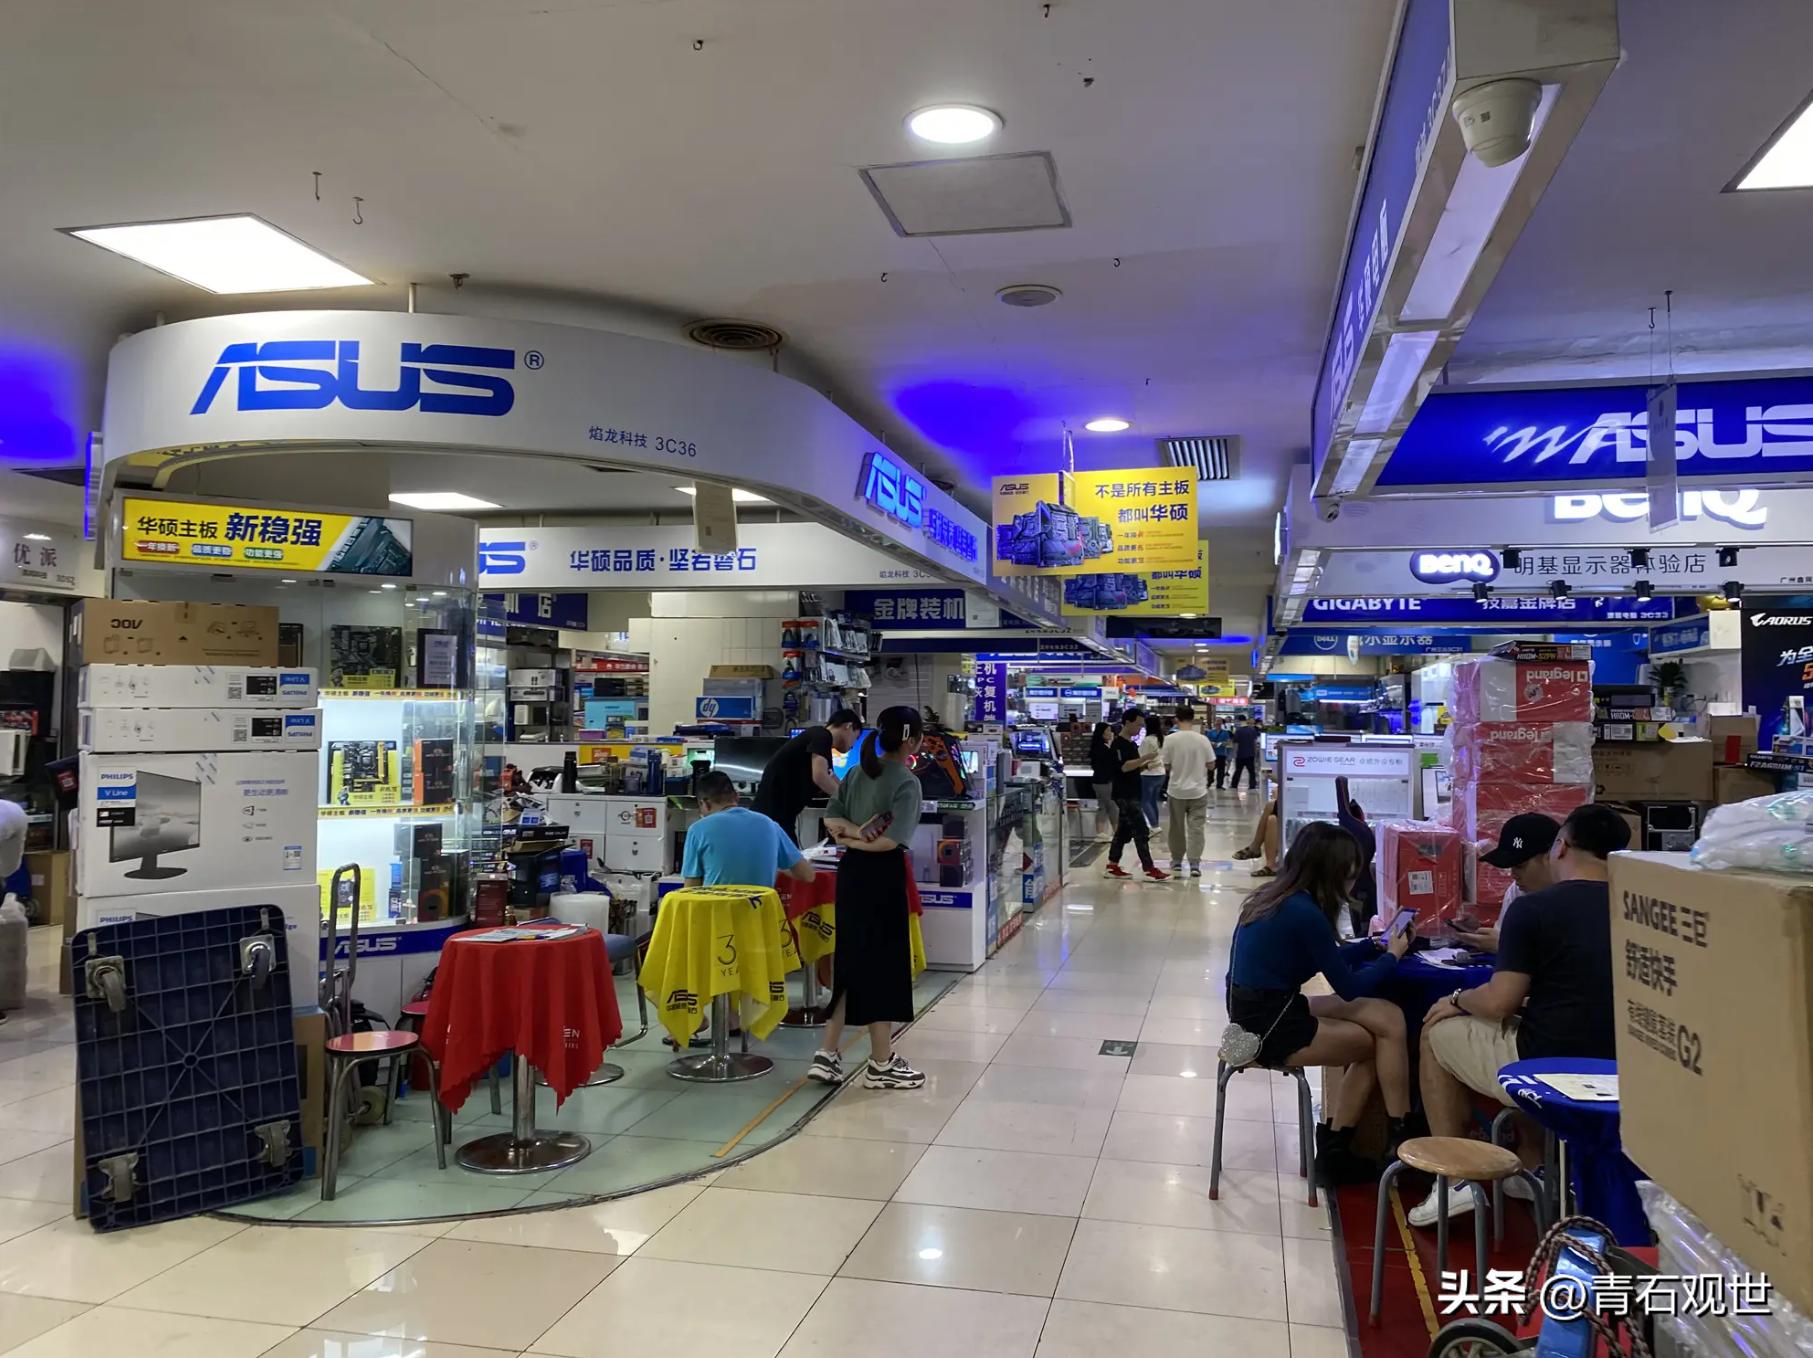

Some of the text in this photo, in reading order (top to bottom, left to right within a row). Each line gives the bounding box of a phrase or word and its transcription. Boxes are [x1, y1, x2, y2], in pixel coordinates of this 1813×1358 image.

[189, 340, 516, 416] ASUS
[655, 436, 698, 458] 3C36
[864, 452, 923, 529] ASUS
[999, 482, 1030, 491] ASUS
[1094, 479, 1190, 499] 不是所有主板
[1117, 502, 1189, 523] 都叫华硕
[136, 512, 323, 547] 华硕主板 新稳强
[1418, 552, 1494, 576] BenQ
[873, 596, 965, 621] 金牌装机
[110, 618, 143, 630] AOC
[1763, 614, 1813, 626] AORUS
[1526, 667, 1575, 683] legrand
[1490, 727, 1540, 742] legrand
[100, 915, 133, 923] PHILIPS
[1622, 889, 1678, 937] SANGEE
[716, 934, 737, 966] 3
[1677, 1023, 1703, 1077] G2
